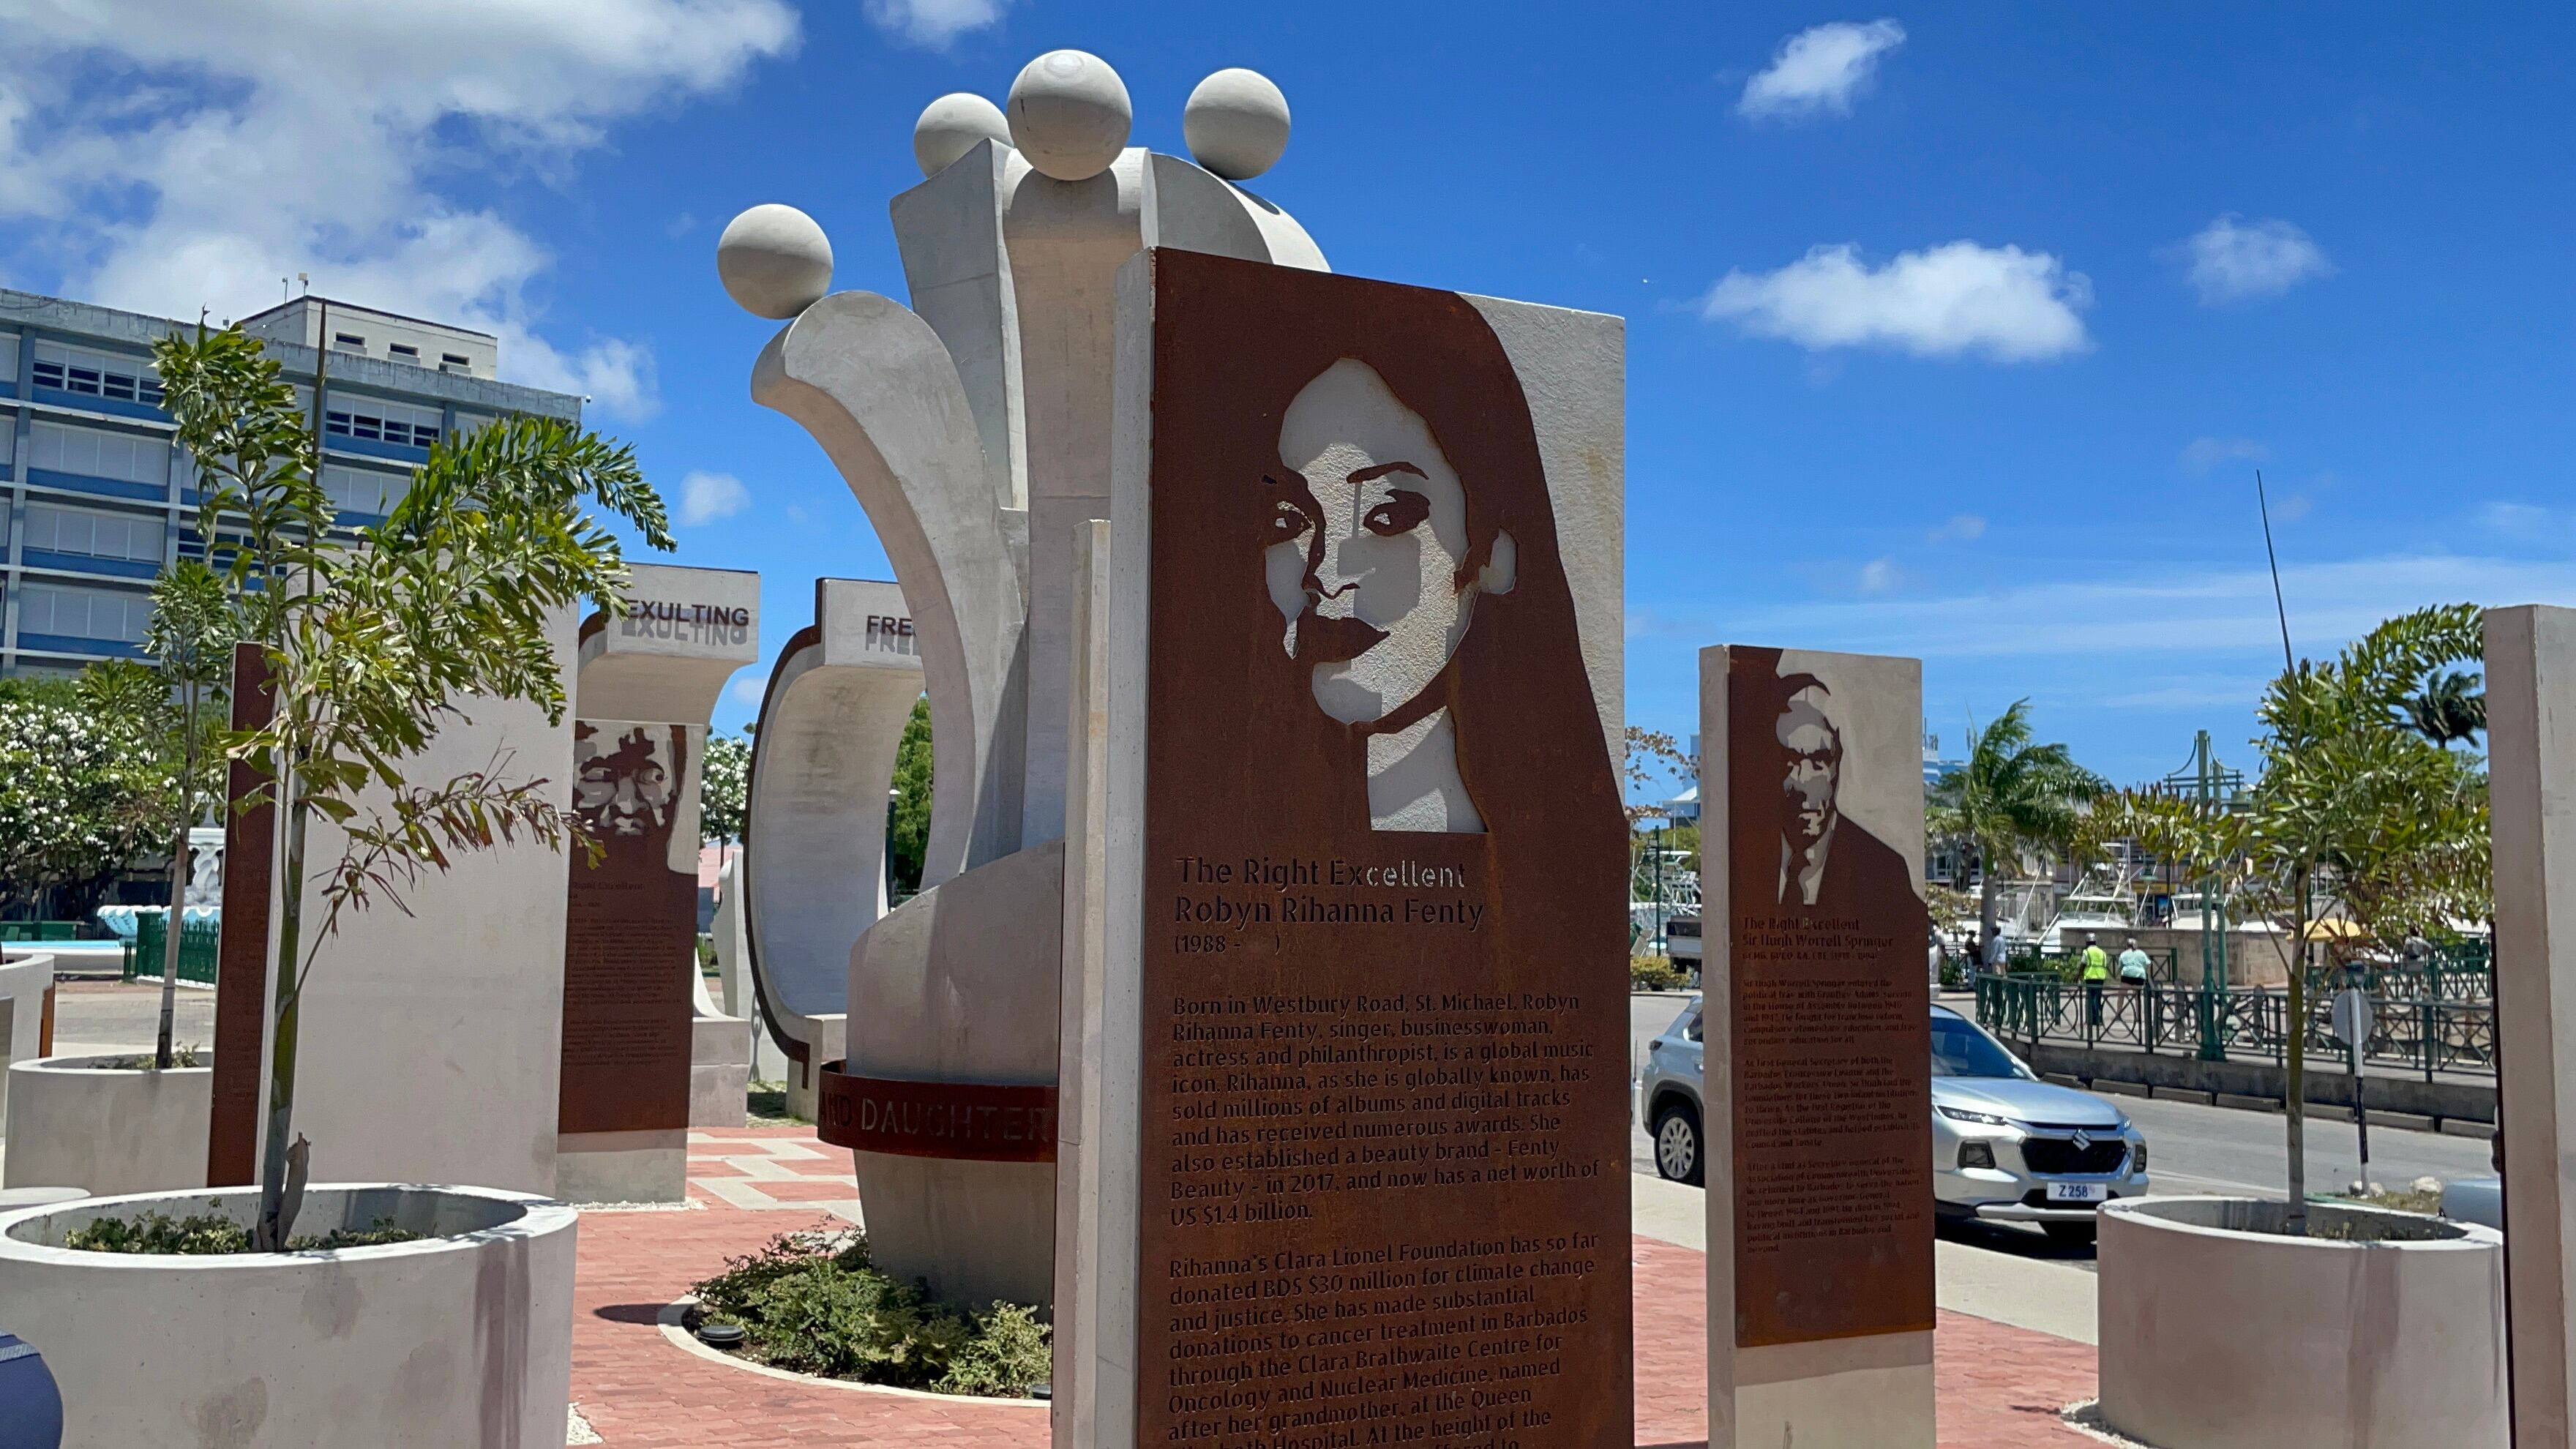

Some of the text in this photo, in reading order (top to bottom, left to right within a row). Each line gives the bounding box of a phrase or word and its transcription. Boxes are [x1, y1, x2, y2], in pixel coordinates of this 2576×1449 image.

[626, 599, 749, 627] EXULTING
[866, 615, 915, 637] FRE
[1175, 856, 1465, 892] The Right Excellent
[1176, 896, 1483, 932] Robyn Rihanna Fenty
[1744, 917, 1860, 932] The Right Excellent
[1175, 935, 1226, 954] (1988
[1743, 935, 1893, 950] Sir Hugh Worrell Springer
[1174, 997, 1221, 1016] Born
[1228, 998, 1246, 1014] in
[1253, 995, 1350, 1019] Westbury
[1415, 995, 1436, 1013] St.
[1522, 994, 1580, 1015] Robyn
[1173, 1022, 1254, 1042] Rihanna
[1173, 1046, 1248, 1068] actress
[1256, 1046, 1292, 1065] and
[1443, 1045, 1458, 1061] is
[1464, 1046, 1473, 1060] a
[1480, 1041, 1538, 1063] global
[1543, 1040, 1593, 1059] music
[1318, 1074, 1338, 1089] as
[1345, 1070, 1379, 1089] she
[1385, 1070, 1399, 1087] is
[1405, 1067, 1483, 1092] globally
[1560, 1065, 1590, 1082] has
[1172, 1089, 1572, 1120] sold millions of albums and digital tracks
[1172, 1114, 1562, 1147] and has received numerous awards. She
[1172, 1153, 1216, 1173] also
[1221, 1145, 1339, 1170] established
[1345, 1152, 1355, 1165] a
[1361, 1143, 1430, 1167] beauty
[1435, 1141, 1489, 1161] brand
[1508, 1139, 1560, 1159] Fenty
[1171, 1178, 1244, 1202] Beauty
[1266, 1177, 1284, 1197] in
[1347, 1172, 1381, 1191] and
[1388, 1170, 1428, 1189] now
[1434, 1168, 1465, 1186] has
[1471, 1171, 1481, 1184] a
[1487, 1165, 1518, 1183] net
[1523, 1162, 1576, 1181] worth
[1580, 1159, 1600, 1180] of
[2059, 1185, 2067, 1197] Z
[1171, 1201, 1314, 1227] US $1.4 billion.
[1171, 1232, 1599, 1279] Rihanna's Clara Lionel Foundation has so far
[1171, 1259, 1595, 1306] donated BDS $30 million for climate change
[1170, 1285, 1535, 1333] and justice. She has made substantial
[1171, 1308, 1589, 1360] donations to cancer treatment in Barbados
[1170, 1333, 1563, 1389] through the Clara Brathwaite Centre for
[1169, 1389, 1272, 1414] Oncology
[1278, 1382, 1314, 1404] and
[1320, 1376, 1398, 1399] Nuclear
[1499, 1358, 1561, 1382] named
[1169, 1420, 1222, 1442] after
[1228, 1414, 1265, 1434] her
[1410, 1398, 1430, 1416] at
[1436, 1393, 1466, 1414] the
[1471, 1389, 1532, 1411] Queen
[1366, 1426, 1388, 1446] At
[1395, 1423, 1424, 1442] the
[1431, 1416, 1492, 1439] height
[1497, 1410, 1514, 1432] of
[1522, 1409, 1551, 1429] the
